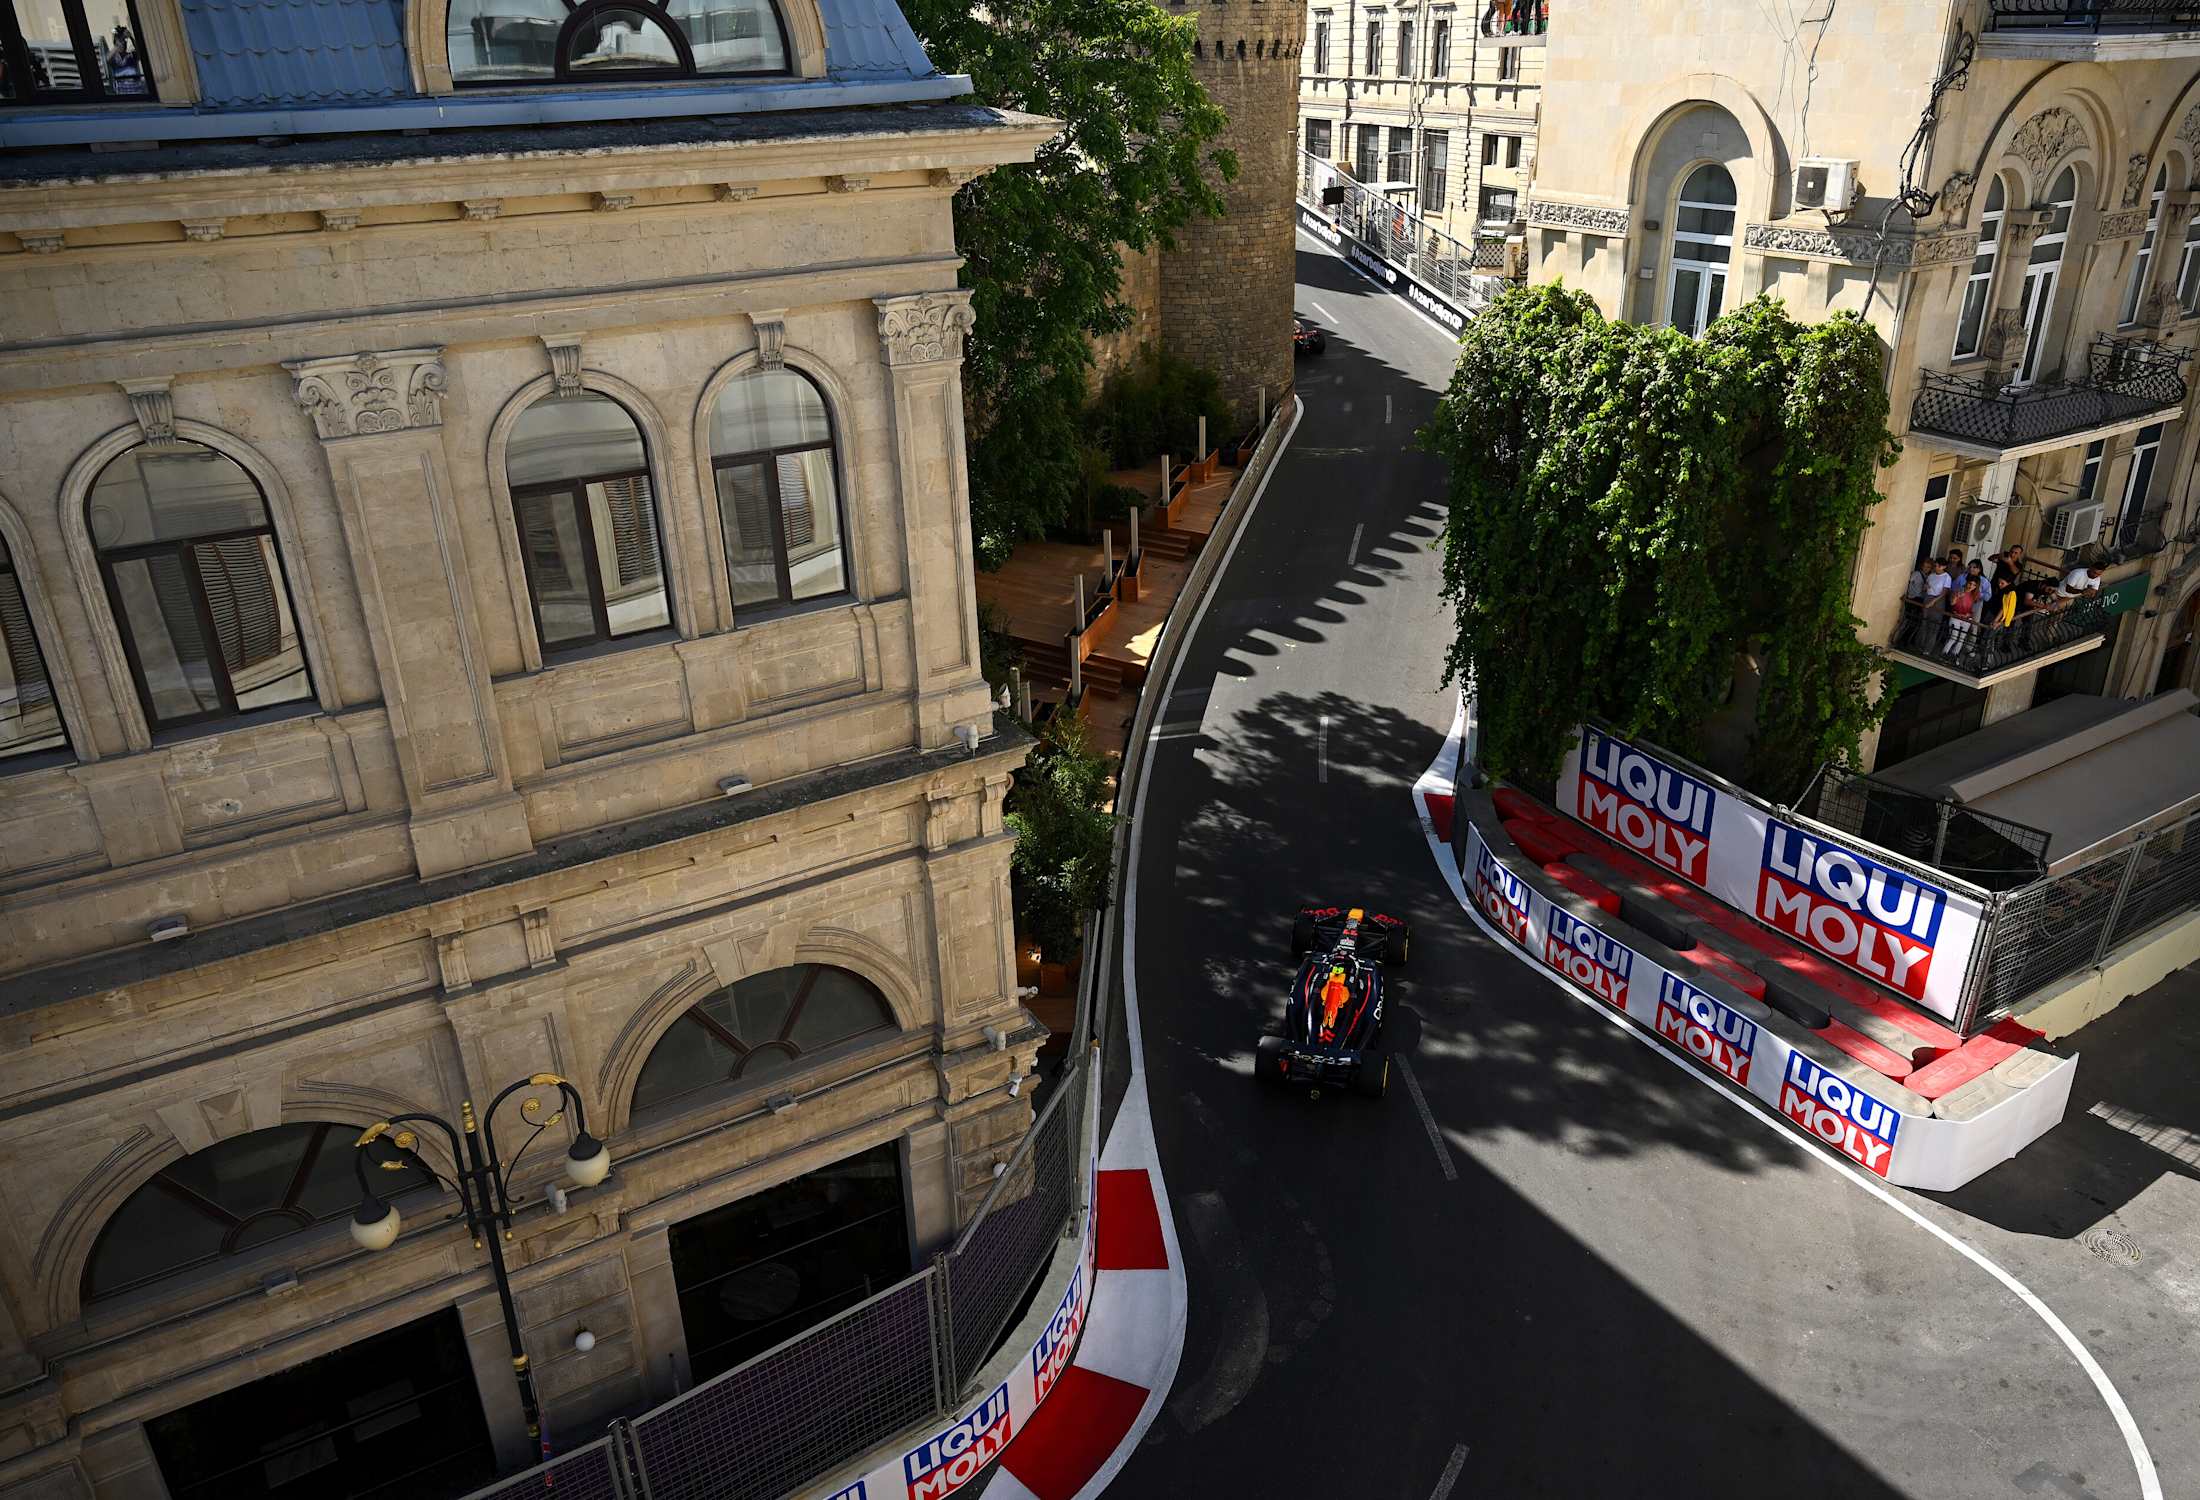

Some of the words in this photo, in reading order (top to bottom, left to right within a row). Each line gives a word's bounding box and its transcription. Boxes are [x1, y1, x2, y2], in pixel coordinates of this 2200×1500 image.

[1586, 732, 1709, 832] LIQUI
[1583, 780, 1706, 875] MOLY
[1475, 874, 1528, 938] MOLY
[1478, 847, 1529, 914] LIQUI
[1770, 825, 1937, 939] LIQUI
[1548, 939, 1628, 1003] MOLY
[1551, 908, 1630, 978] LIQUI
[1763, 876, 1930, 988] MOLY
[1659, 1005, 1749, 1079] MOLY
[1663, 976, 1752, 1052] LIQUI
[1783, 1087, 1890, 1169] MOLY
[1789, 1055, 1894, 1140] LIQUI
[1035, 1268, 1081, 1373] LIQUI
[1037, 1297, 1082, 1400] MOLY
[909, 1387, 1006, 1481] LIQUI
[913, 1413, 1009, 1500] MOLY
